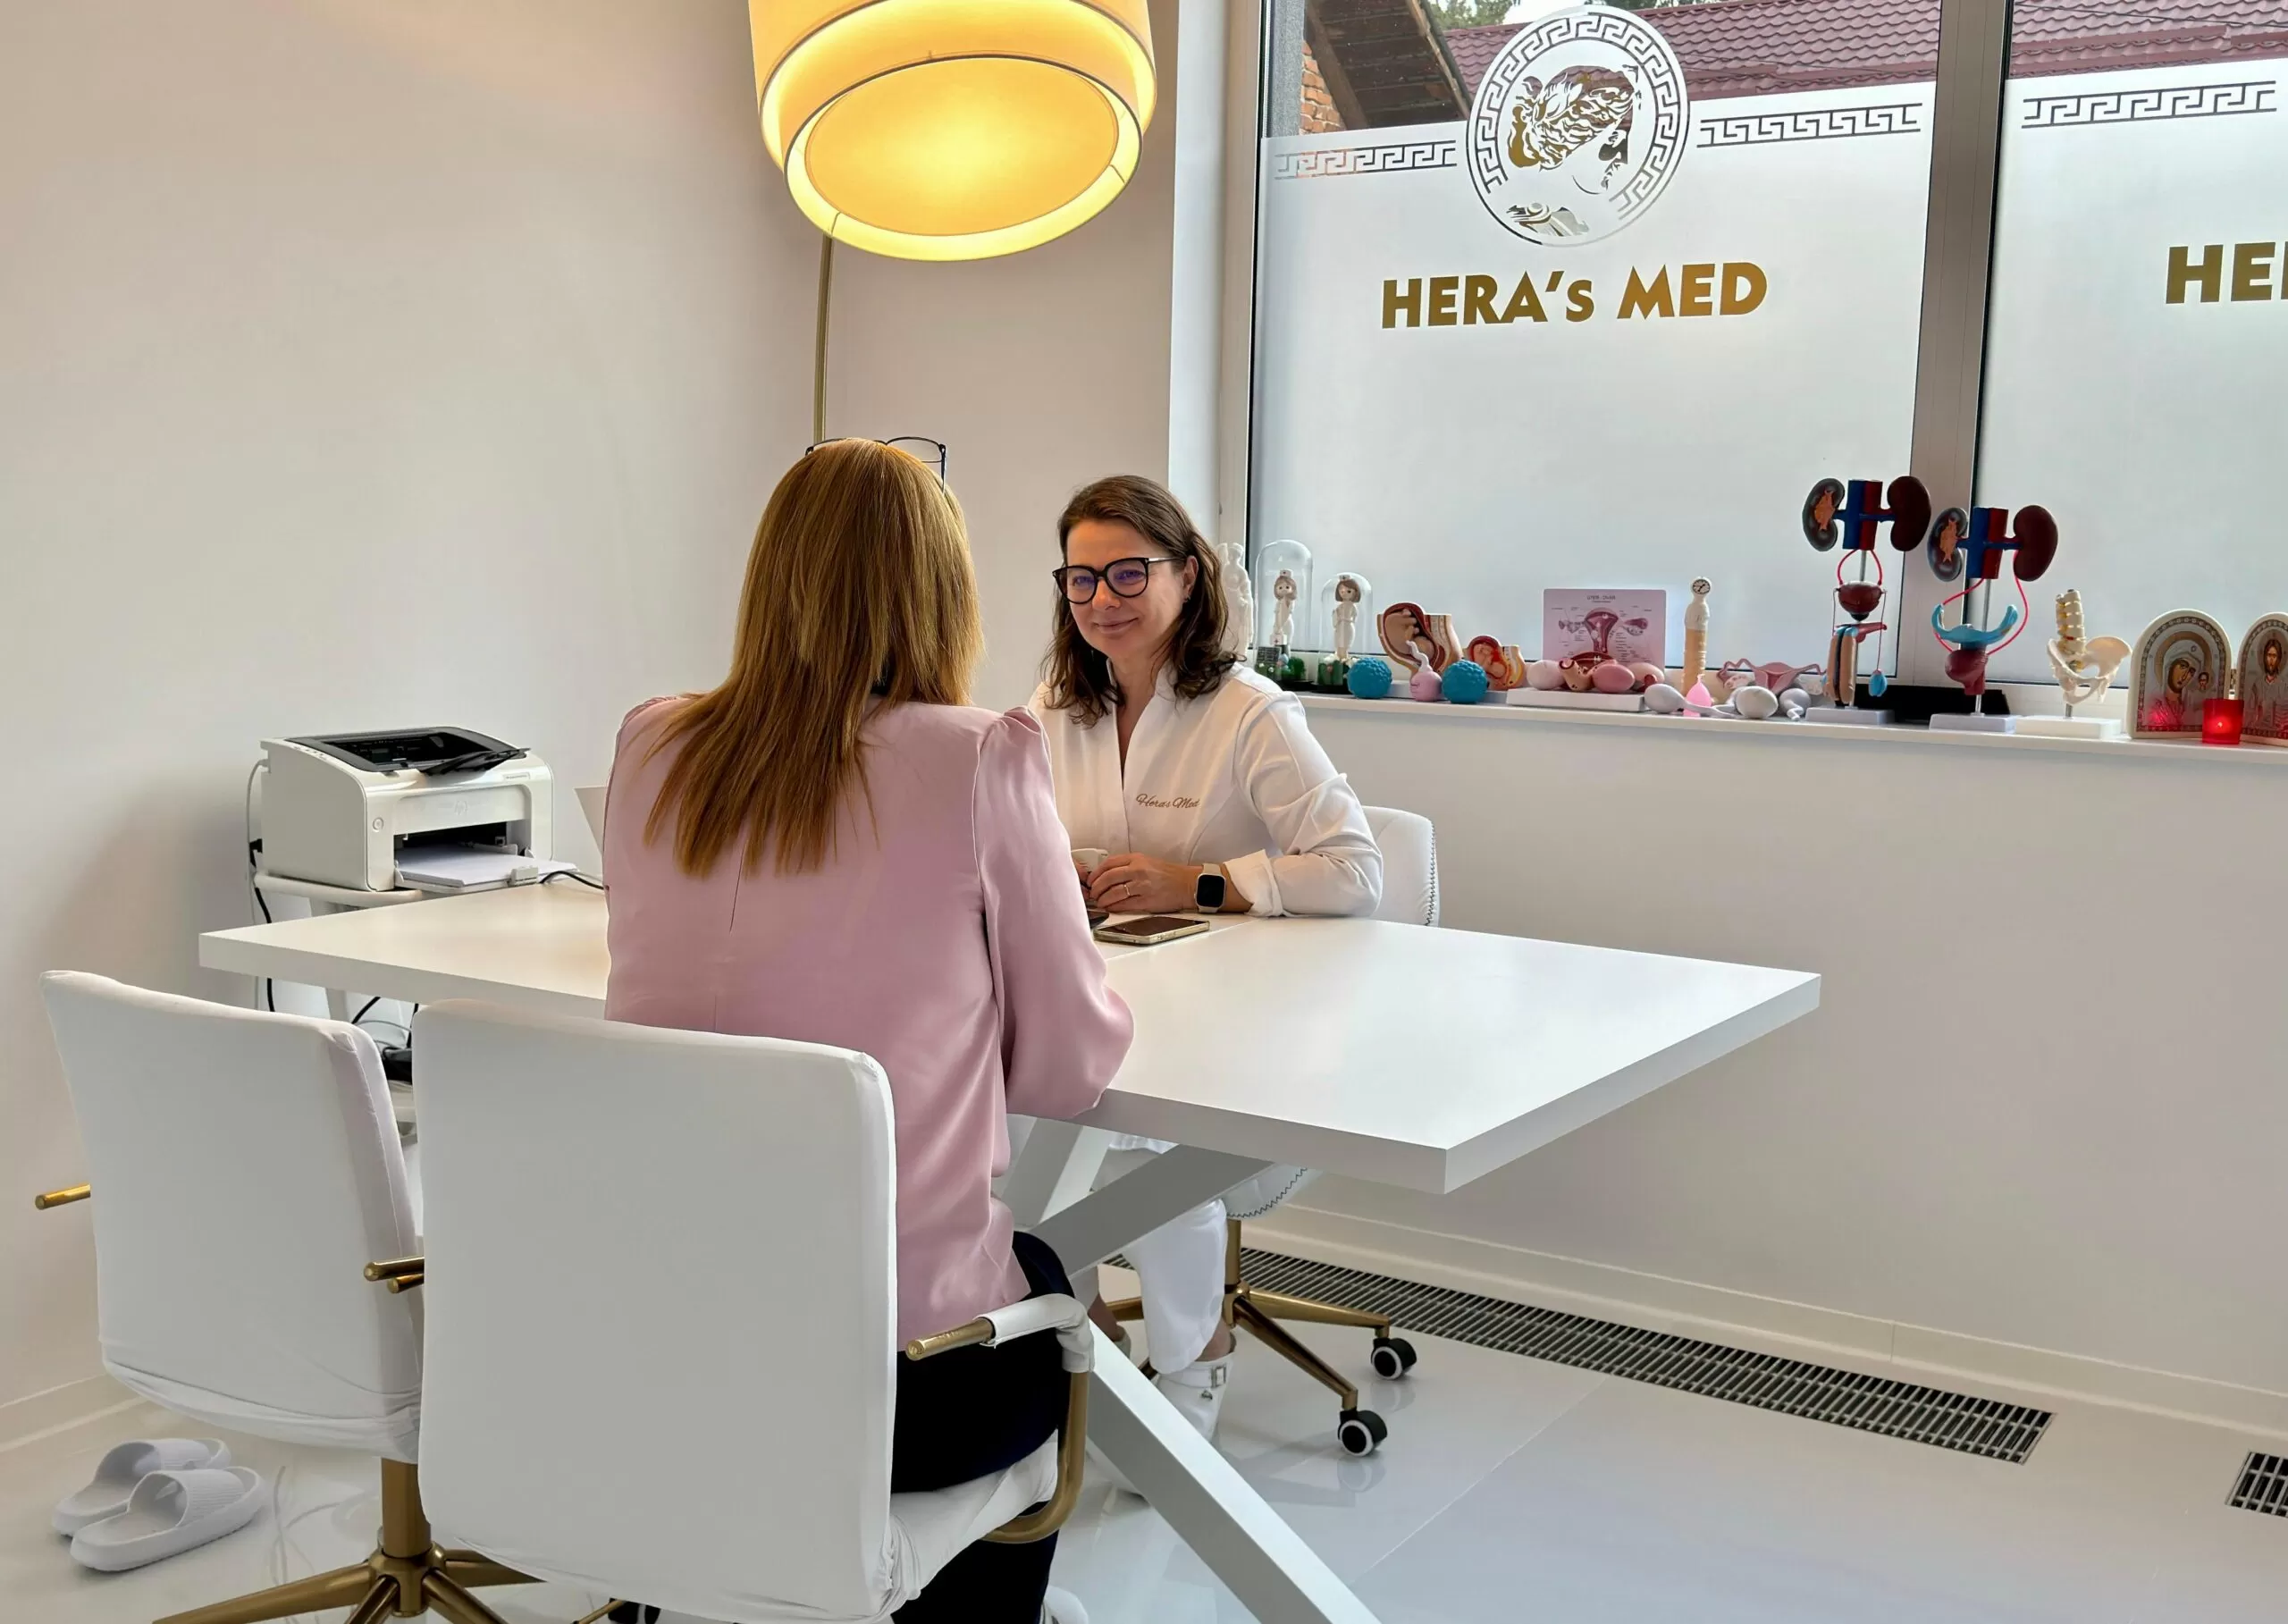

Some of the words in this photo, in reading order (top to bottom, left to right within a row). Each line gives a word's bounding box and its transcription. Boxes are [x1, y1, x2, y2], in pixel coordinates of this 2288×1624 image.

[1382, 270, 1594, 329] HERA's
[1617, 262, 1768, 320] MED
[2166, 241, 2288, 304] HE
[1173, 796, 1200, 808] Med
